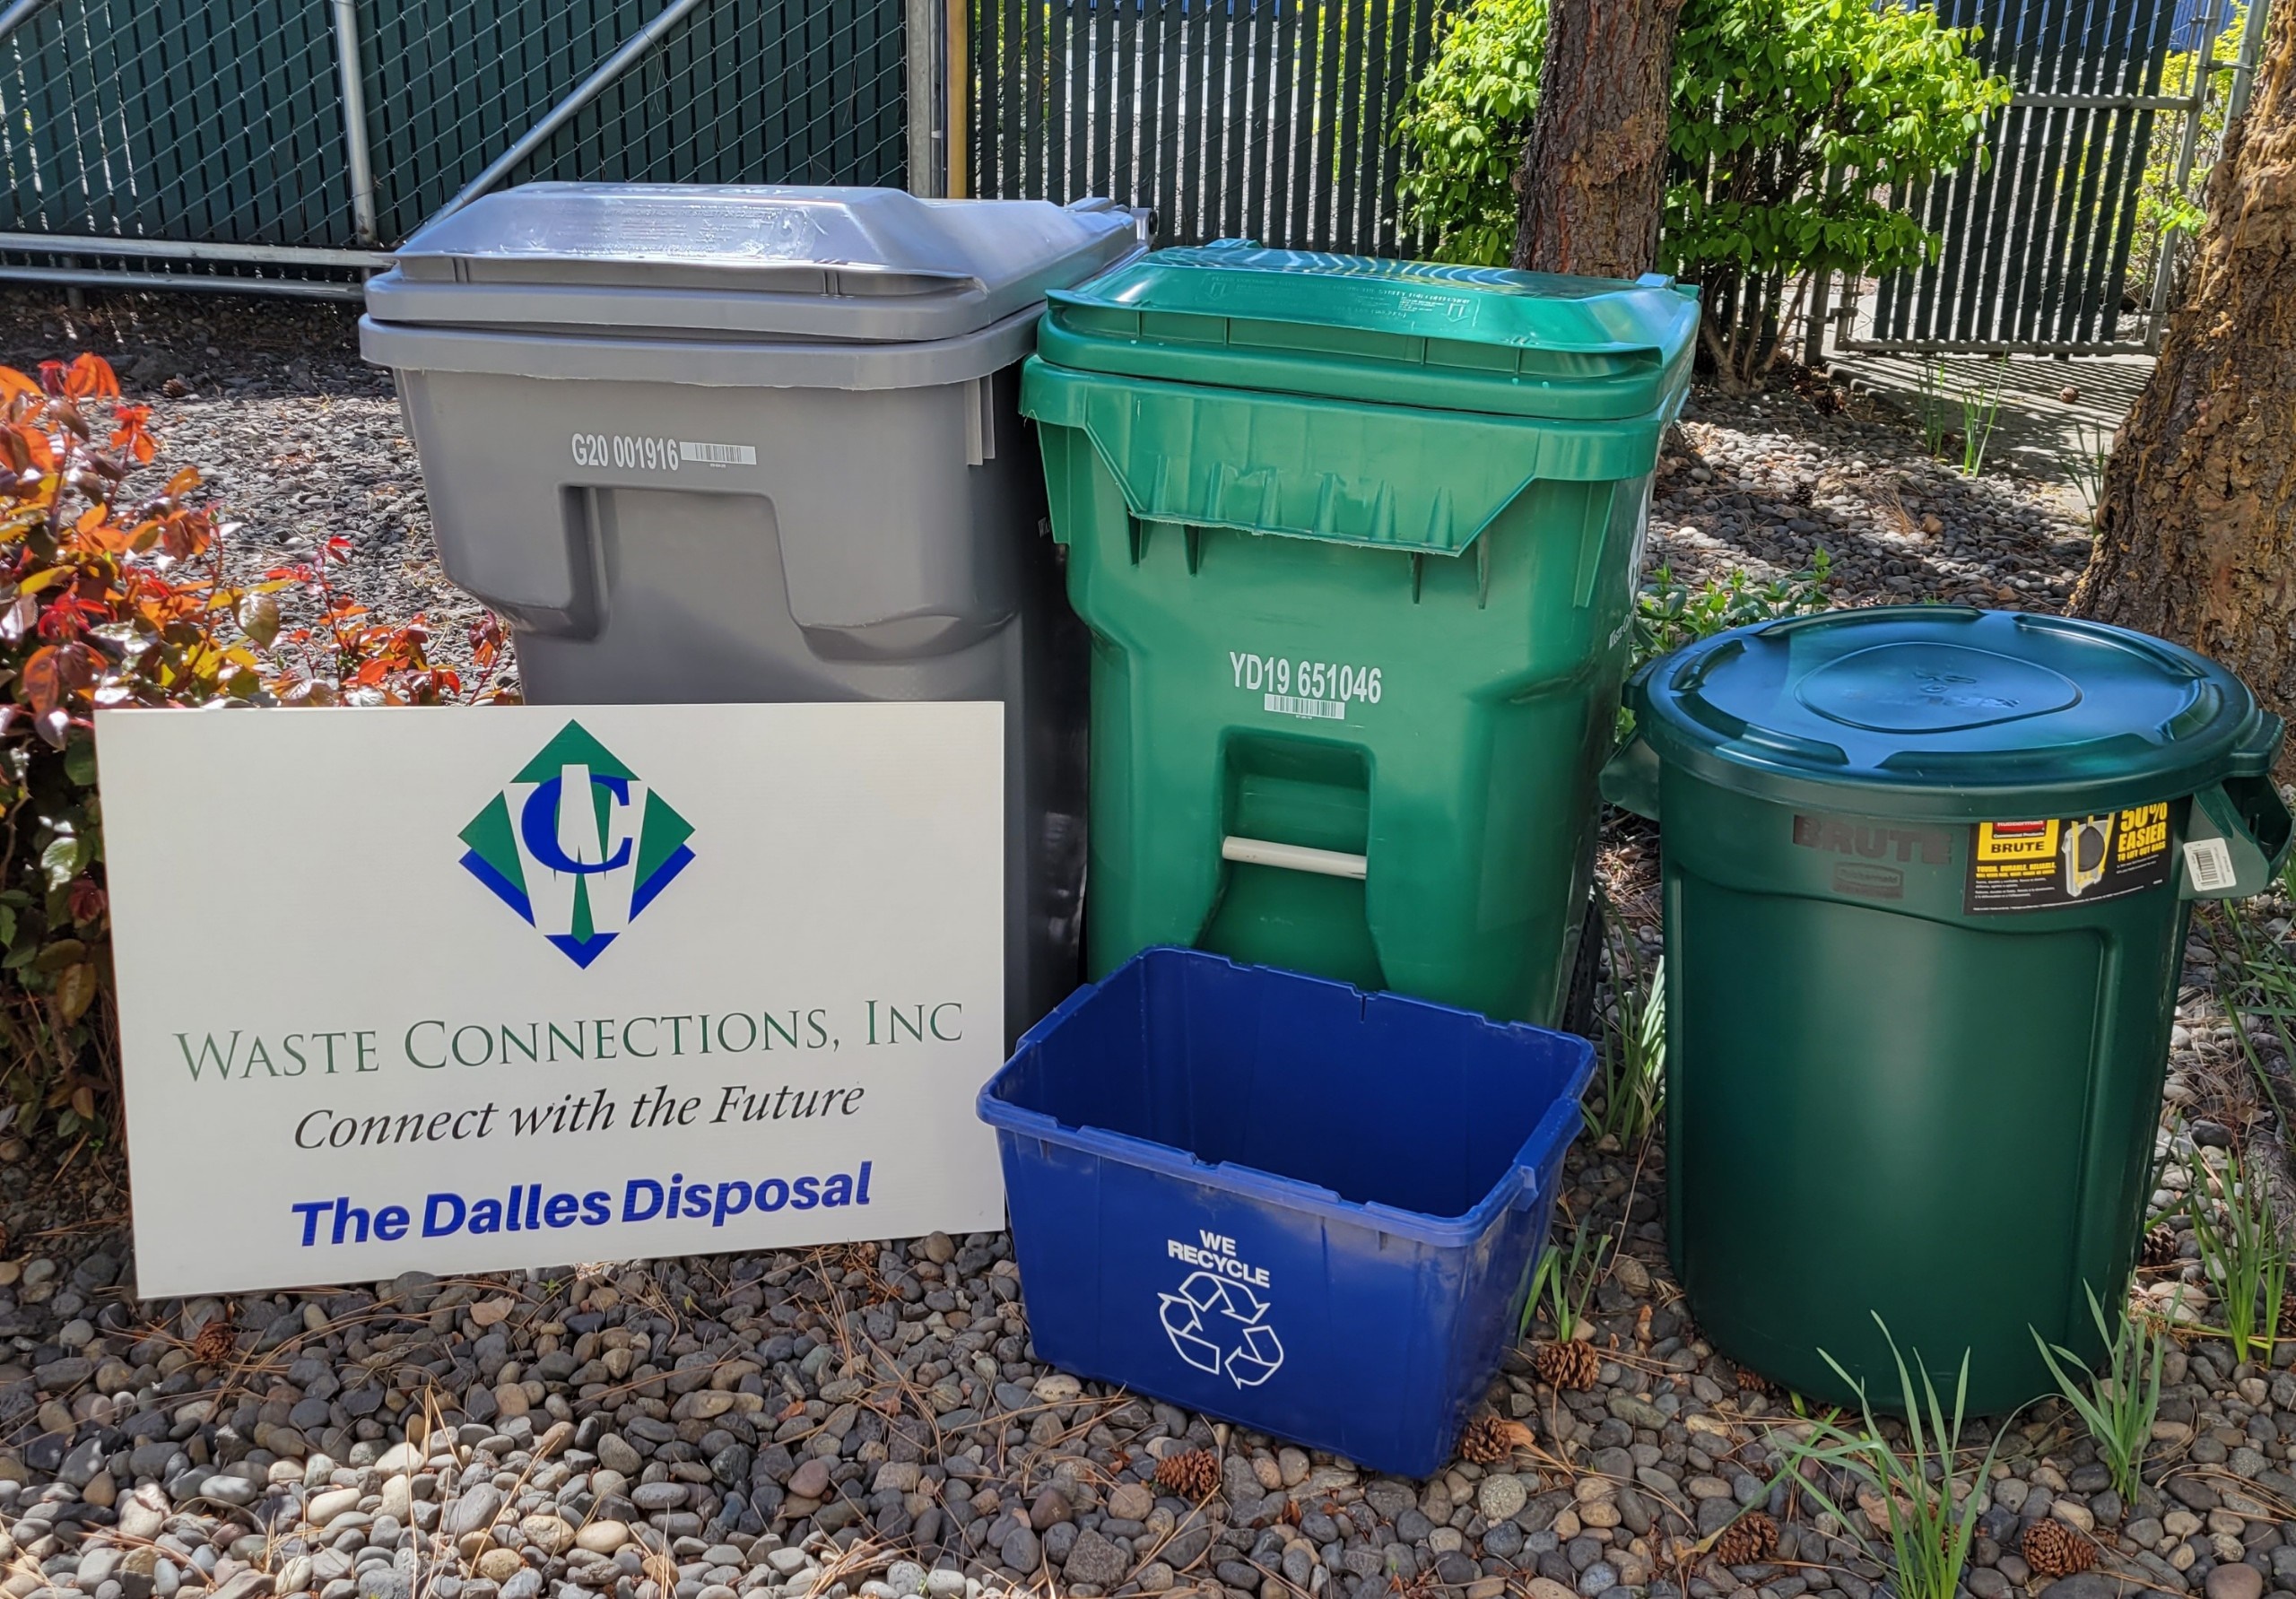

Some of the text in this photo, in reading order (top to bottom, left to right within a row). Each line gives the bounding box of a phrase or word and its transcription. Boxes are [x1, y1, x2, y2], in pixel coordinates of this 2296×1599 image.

[571, 433, 679, 471] G20 001916
[1230, 651, 1382, 704] YD19 651046
[1793, 813, 1952, 865] BRUTE
[1991, 841, 2045, 854] BRUTE
[2118, 821, 2167, 853] EASIER
[177, 1000, 962, 1082] WASTE CONNECTIONS, INC
[294, 1082, 865, 1149] Connect with the Future
[291, 1160, 872, 1247] The Dalles Disposal
[1168, 1239, 1271, 1289] RECYCLE
[1199, 1230, 1237, 1256] WE
